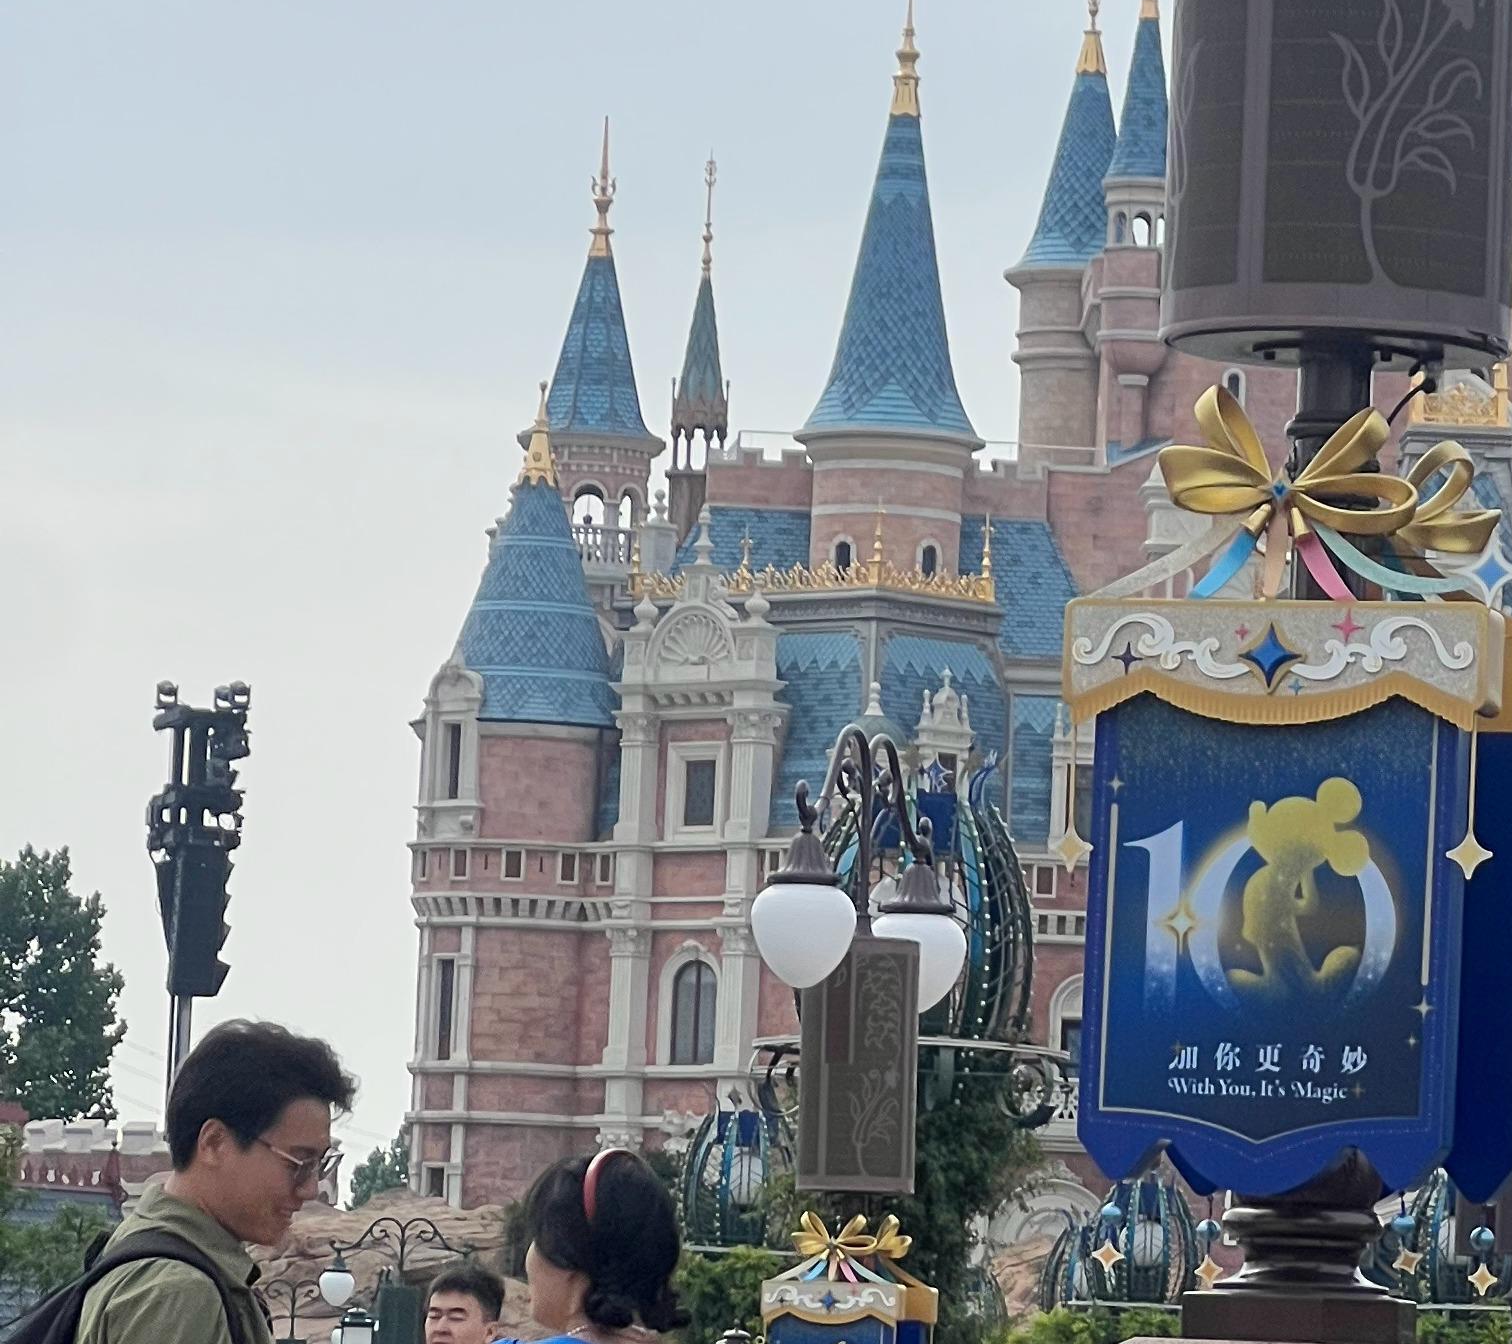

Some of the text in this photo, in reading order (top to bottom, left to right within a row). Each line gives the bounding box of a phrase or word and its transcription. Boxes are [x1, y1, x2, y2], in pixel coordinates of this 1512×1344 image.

[1122, 819, 1397, 1007] 10
[1167, 1077, 1348, 1104] With You, It's Magic
